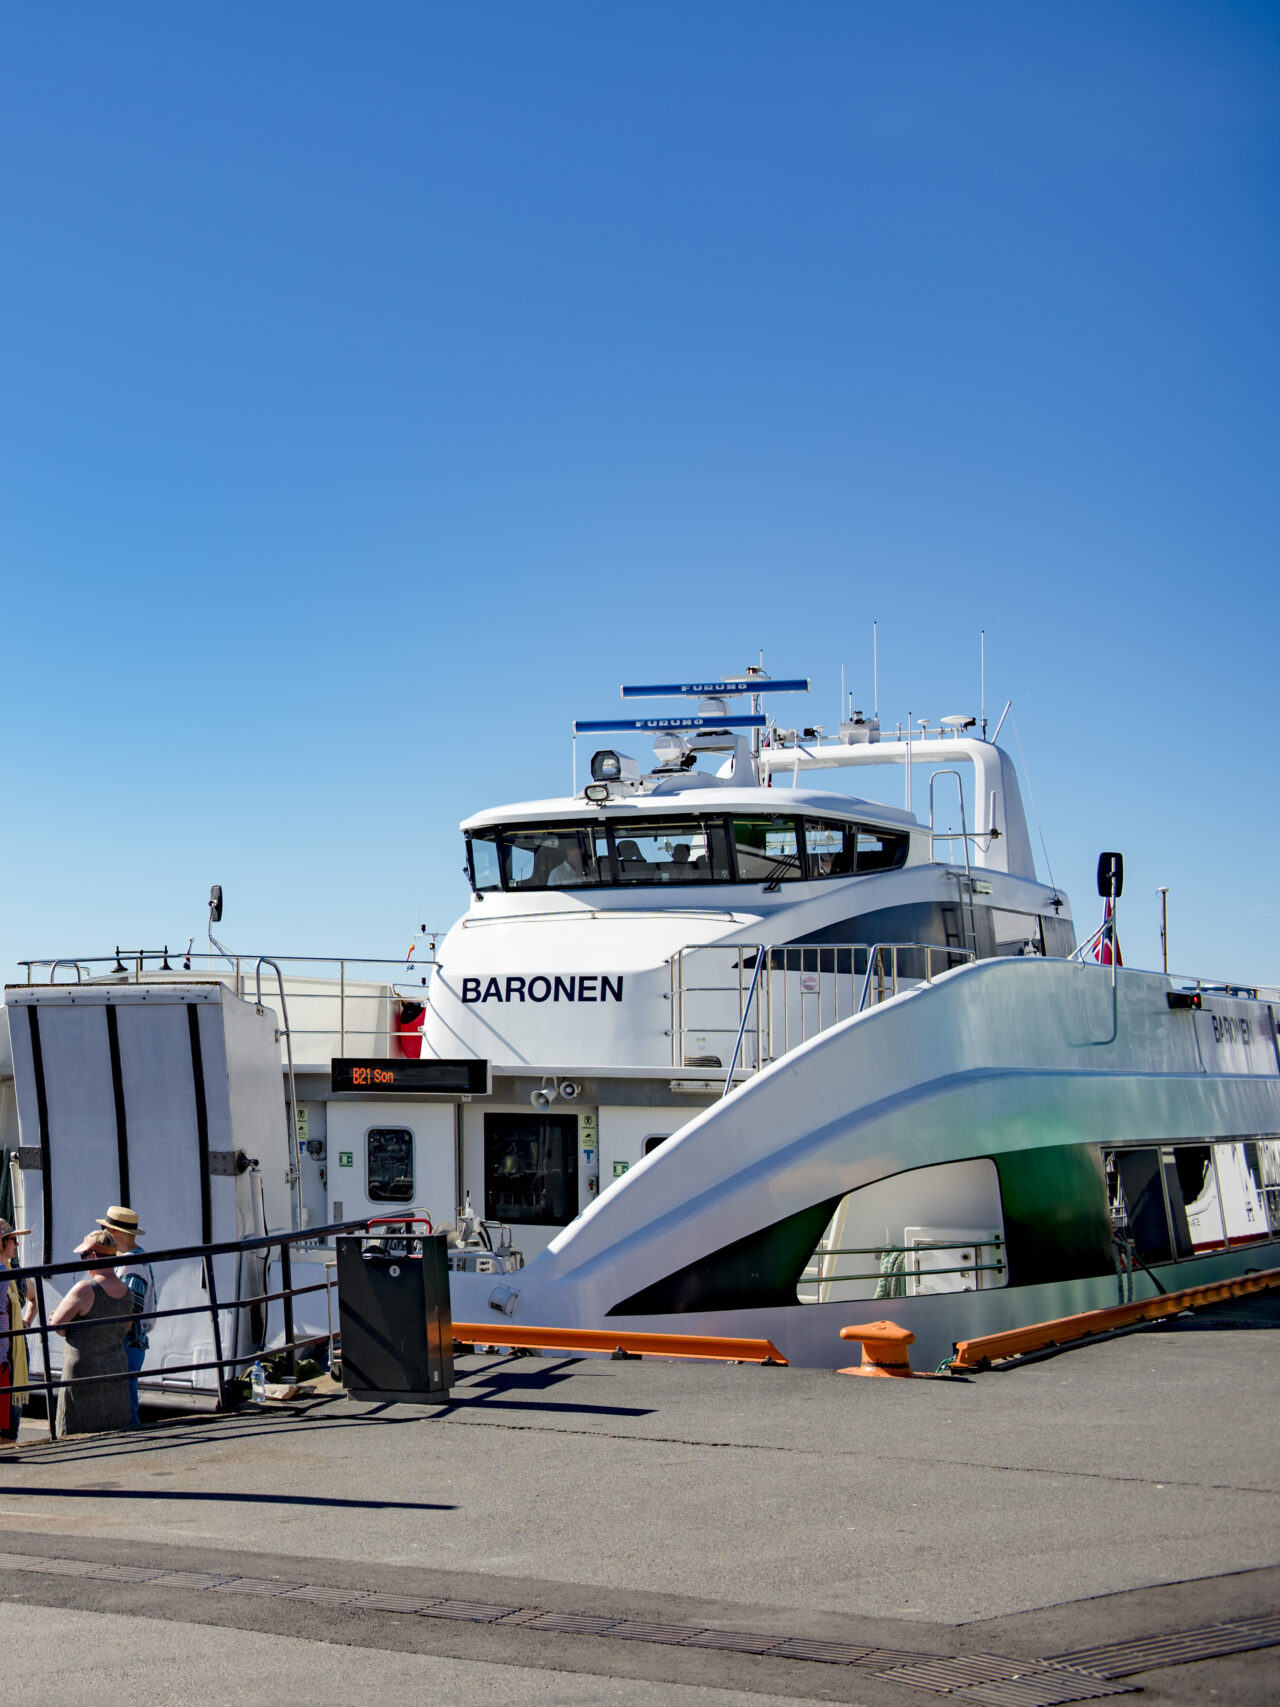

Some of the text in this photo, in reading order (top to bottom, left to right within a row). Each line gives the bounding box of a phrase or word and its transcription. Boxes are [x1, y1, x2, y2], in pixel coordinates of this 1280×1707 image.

[681, 683, 748, 692] FURUNO
[635, 718, 704, 728] FURUNO
[461, 975, 624, 1003] BARONEN
[352, 1067, 394, 1085] B21 Son
